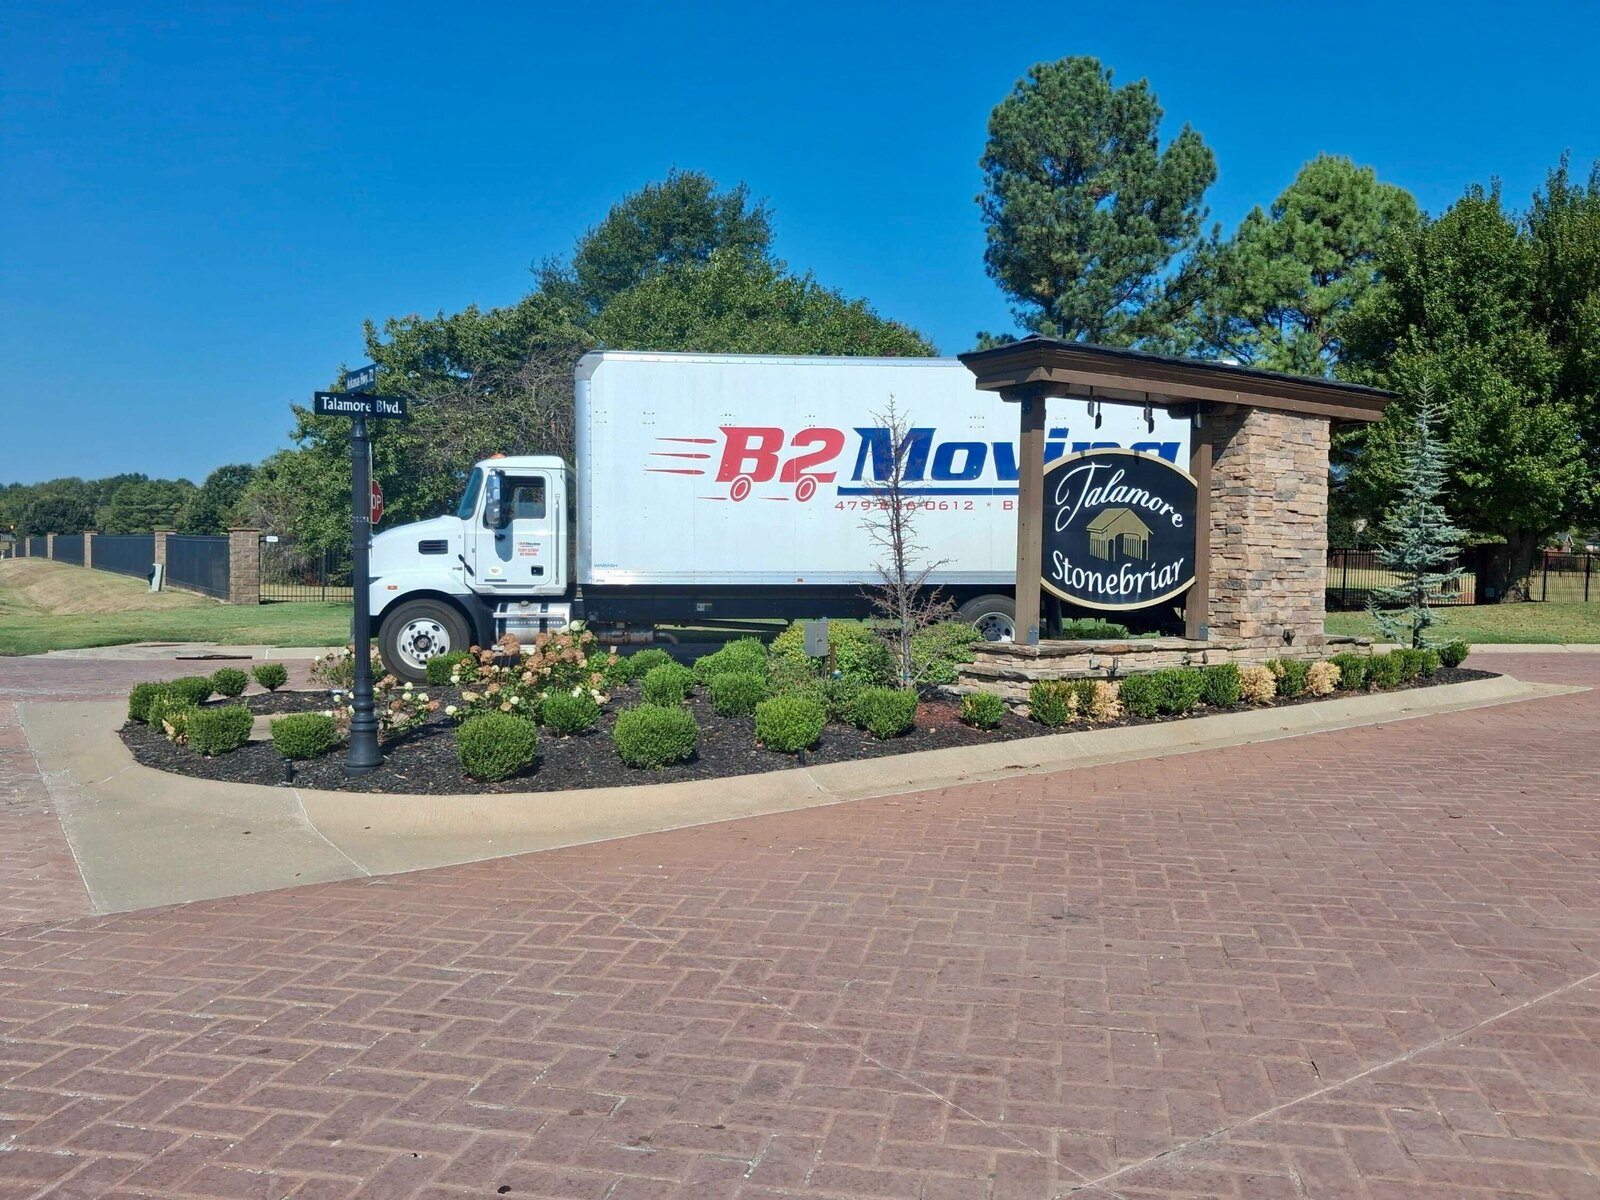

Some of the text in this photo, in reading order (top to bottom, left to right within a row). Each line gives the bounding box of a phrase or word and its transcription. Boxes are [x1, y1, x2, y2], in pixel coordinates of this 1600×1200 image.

[321, 396, 402, 414] Talamore Blvd.
[715, 427, 1182, 484] B2 Movi
[1055, 462, 1184, 532] Talamore
[1052, 550, 1184, 594] Stonebriar
